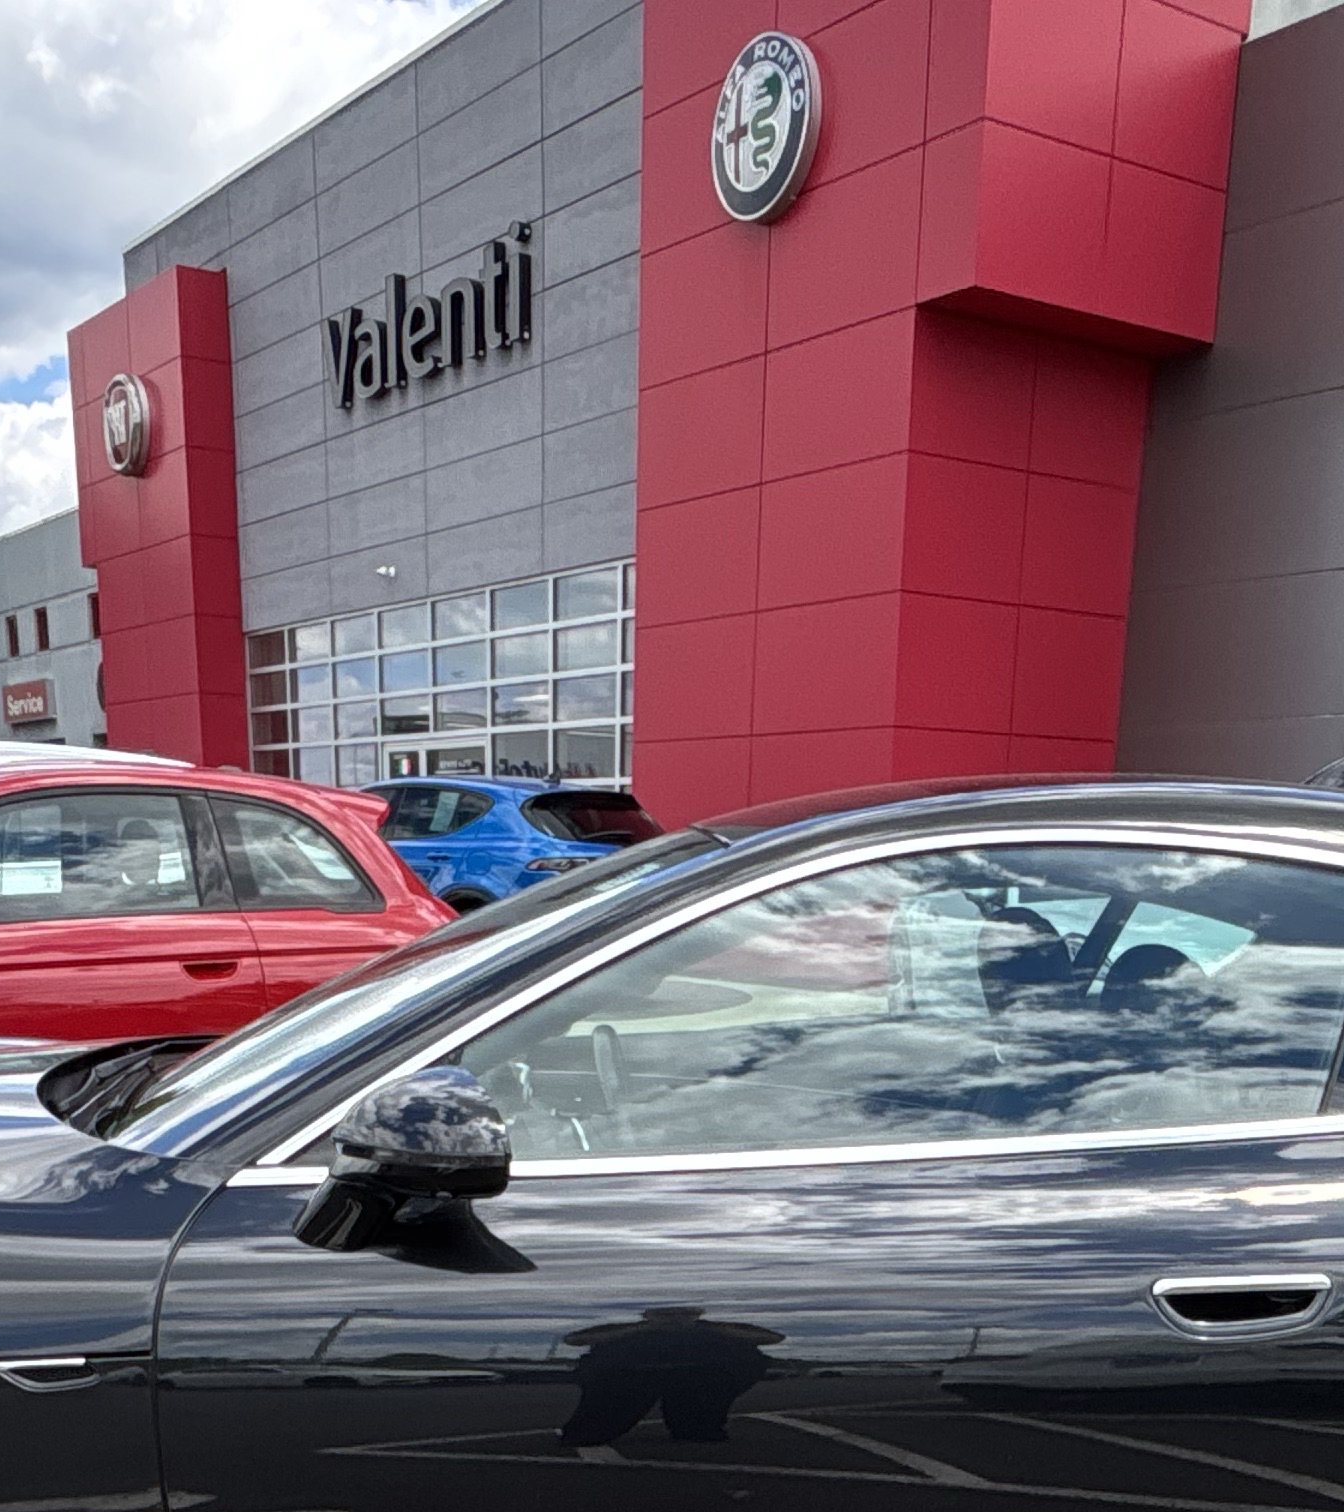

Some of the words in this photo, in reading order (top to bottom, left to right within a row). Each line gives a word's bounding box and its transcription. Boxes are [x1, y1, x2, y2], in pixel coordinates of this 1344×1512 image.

[715, 64, 746, 143] ALFA
[753, 40, 805, 111] ROMEO
[321, 220, 532, 409] Valenti
[7, 691, 44, 717] Service
